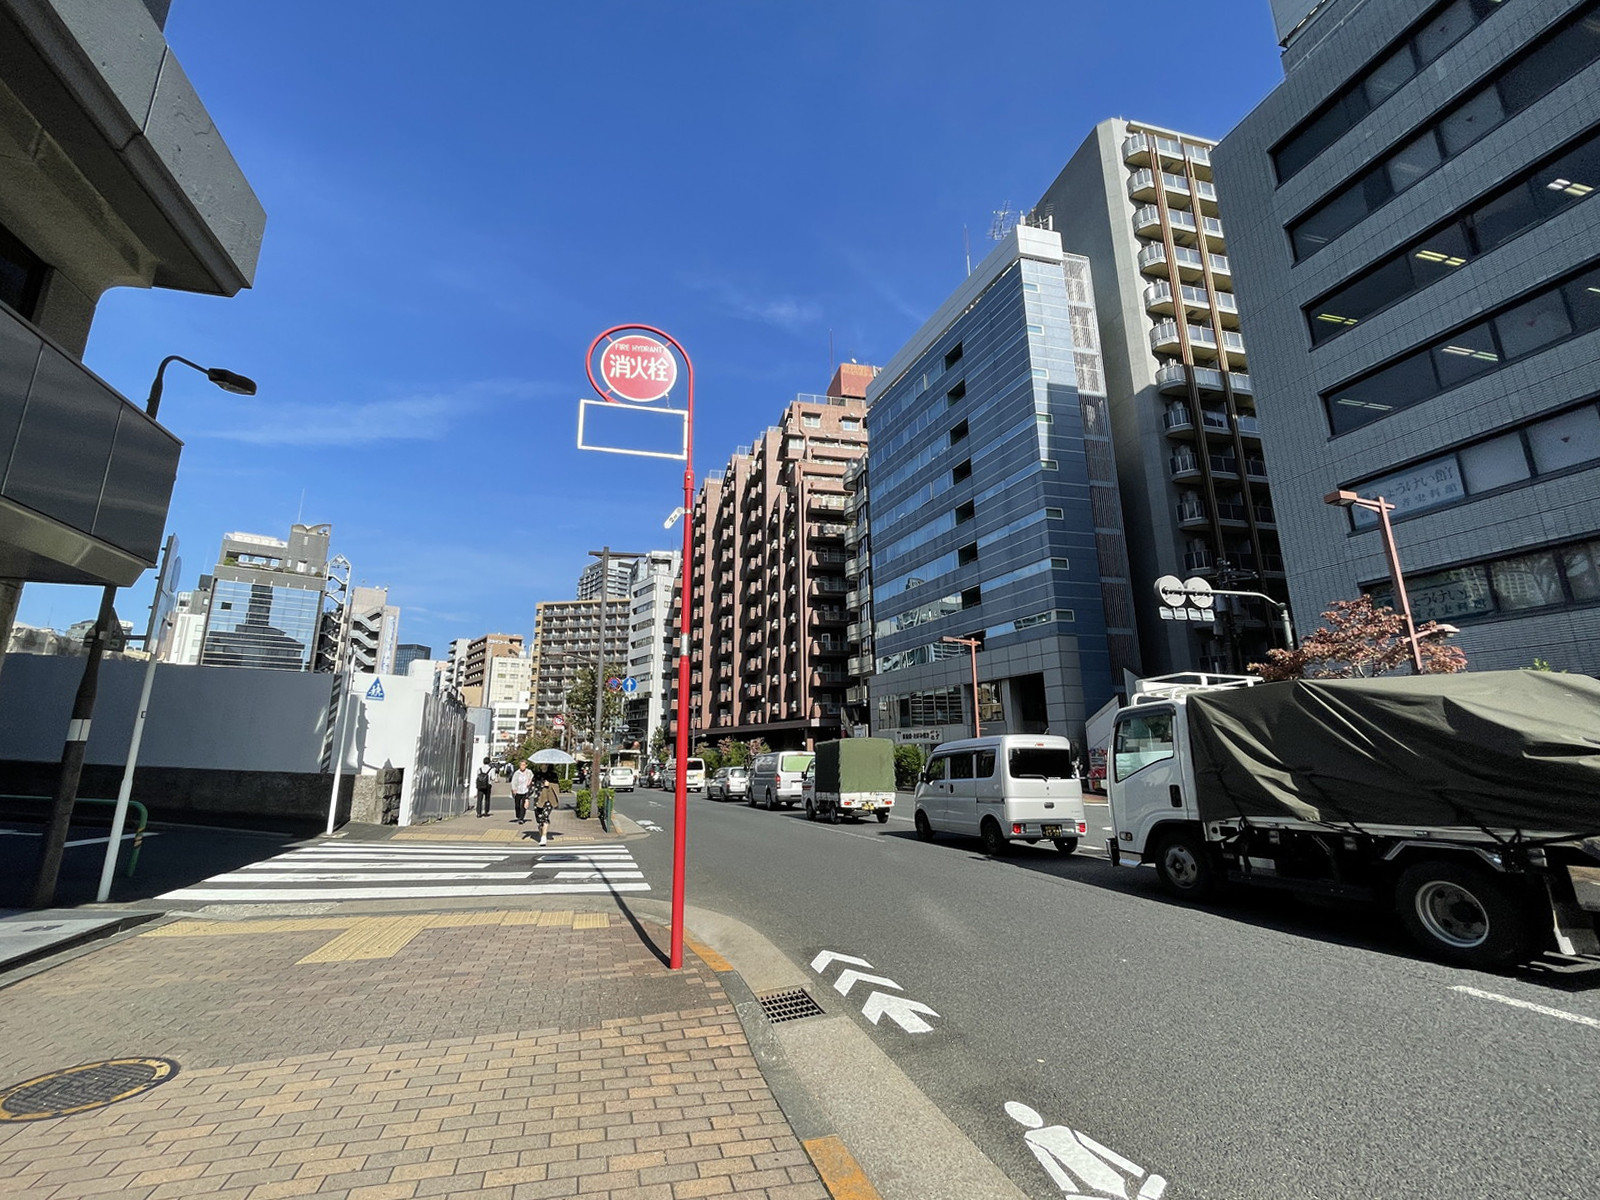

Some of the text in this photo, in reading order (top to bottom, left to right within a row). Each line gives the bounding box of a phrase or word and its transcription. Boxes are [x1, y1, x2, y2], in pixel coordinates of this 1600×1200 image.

[614, 343, 664, 353] FIRE HYDRANT
[609, 354, 670, 382] 消火栓
